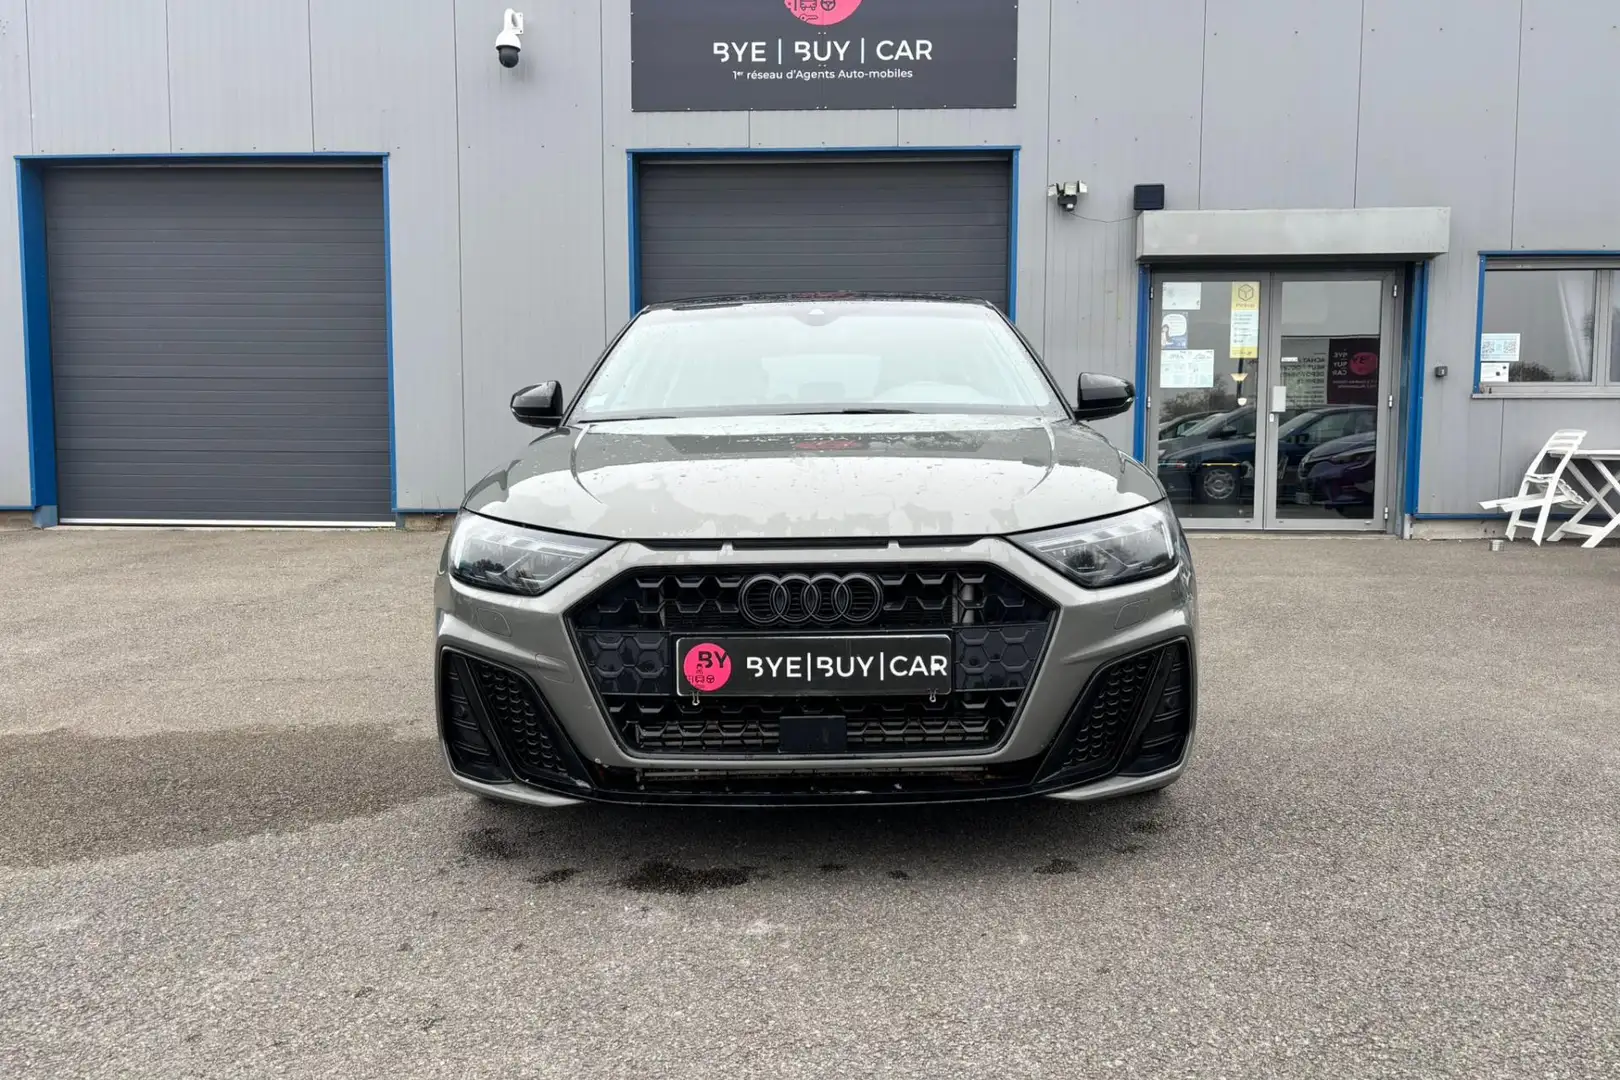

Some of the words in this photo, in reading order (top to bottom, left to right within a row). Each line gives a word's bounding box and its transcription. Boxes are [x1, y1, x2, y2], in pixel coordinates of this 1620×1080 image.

[713, 41, 767, 63] BYE
[794, 40, 851, 62] BUY
[876, 39, 933, 61] CAR
[747, 70, 783, 80] réseau
[838, 69, 913, 80] Auto-mobiles
[698, 651, 728, 669] BY
[746, 656, 802, 678] BYE
[816, 656, 874, 678] BUY
[889, 655, 948, 677] CAR
